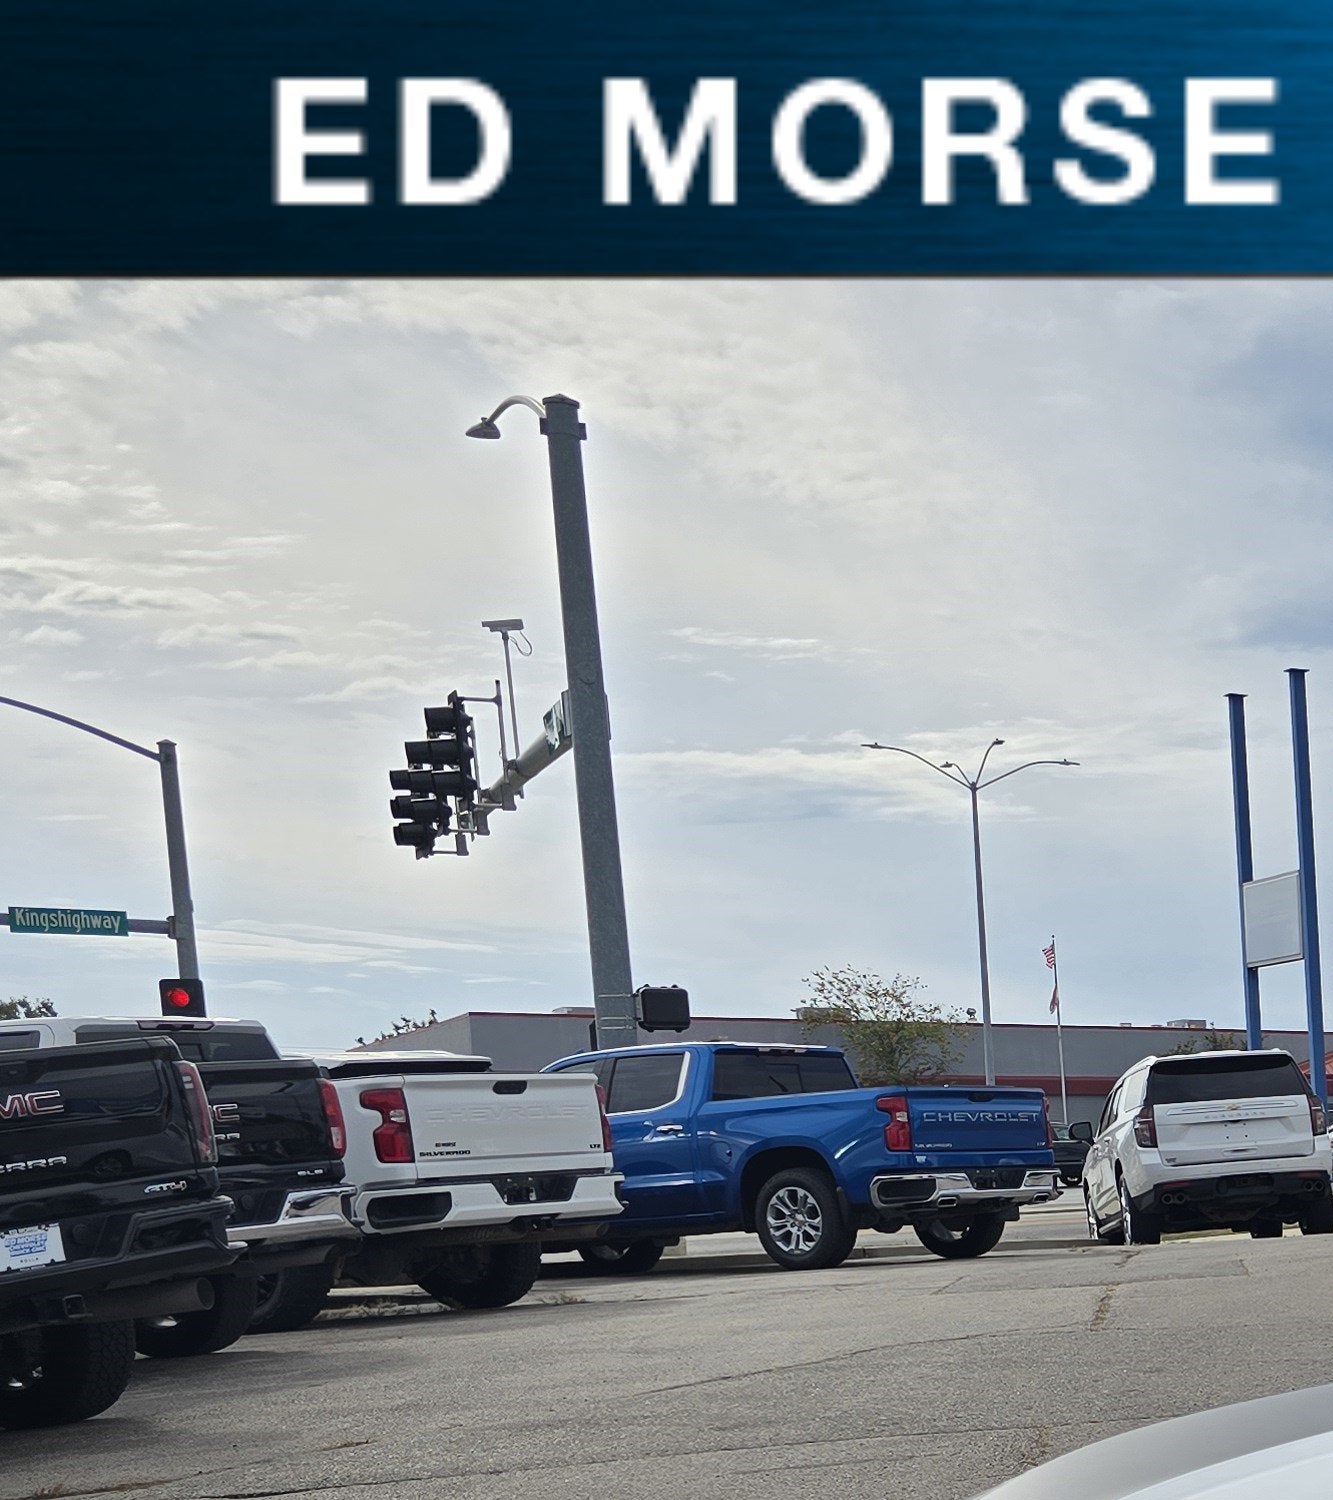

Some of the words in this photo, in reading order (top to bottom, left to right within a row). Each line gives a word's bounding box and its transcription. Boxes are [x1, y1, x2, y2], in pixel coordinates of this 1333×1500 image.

[15, 908, 121, 933] Kingshighway
[923, 1112, 1039, 1122] CHEVROLET
[419, 1149, 471, 1157] SILVERADO
[0, 1155, 67, 1174] RRA
